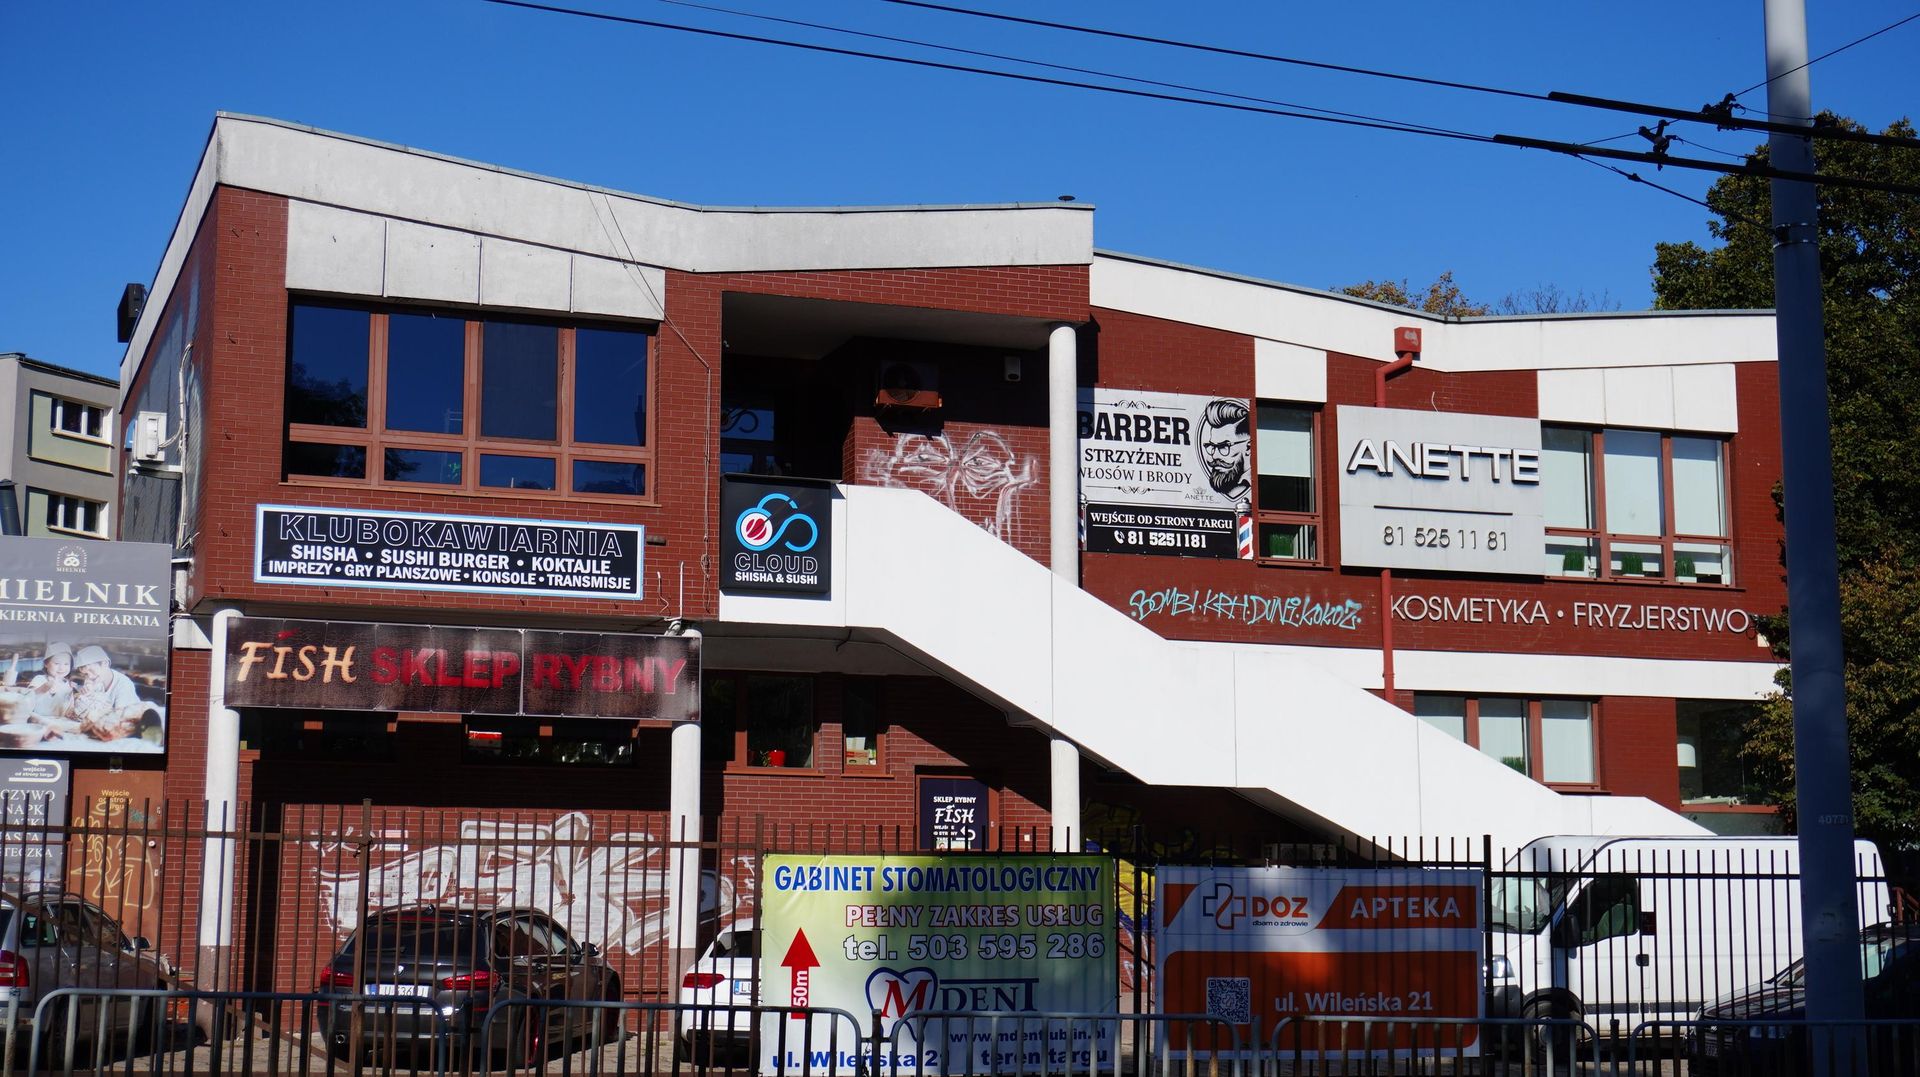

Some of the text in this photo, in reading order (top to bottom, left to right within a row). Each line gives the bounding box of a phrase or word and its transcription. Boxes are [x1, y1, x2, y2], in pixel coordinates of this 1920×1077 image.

[1077, 410, 1191, 446] BARBER
[1084, 447, 1182, 467] STRZYŻENIE
[1346, 438, 1540, 486] ANETTE
[1078, 465, 1193, 484] WŁOSÓW I BRODY
[1090, 511, 1233, 529] WEJŚCIE OD STRONY TARGU
[279, 514, 623, 558] KLUBOKAWIARNIA
[1127, 531, 1207, 548] 81 5251181
[1383, 526, 1507, 551] 81 525 11 81
[290, 544, 611, 576] SHISHA SUSHI BURGER KOKTAJLE
[734, 552, 818, 574] CLOUD
[268, 560, 631, 590] IMPREZY GRY PLANSZOWE KONSOLE TRANSMISJE
[735, 571, 818, 585] SHISHA & SUSHI
[73, 612, 161, 627] PIEKARNIA
[1390, 594, 1750, 634] KOSMETYKA FRYZJERSTWO
[236, 640, 688, 696] FISH SKLEP RYBNY
[933, 795, 977, 804] SKLEP RYBNY
[934, 808, 975, 824] FISH
[774, 865, 876, 892] GABINET
[882, 866, 1101, 892] STOMATOLOGICZNY
[845, 904, 1105, 928] PEŁNY ZAKRES USŁUG
[1251, 896, 1309, 918] DOZ
[1350, 897, 1461, 919] APTEKA
[842, 932, 1106, 961] tel. 503 595 286
[793, 970, 808, 1008] 50m
[1274, 991, 1433, 1013] ul. Wileńska 21
